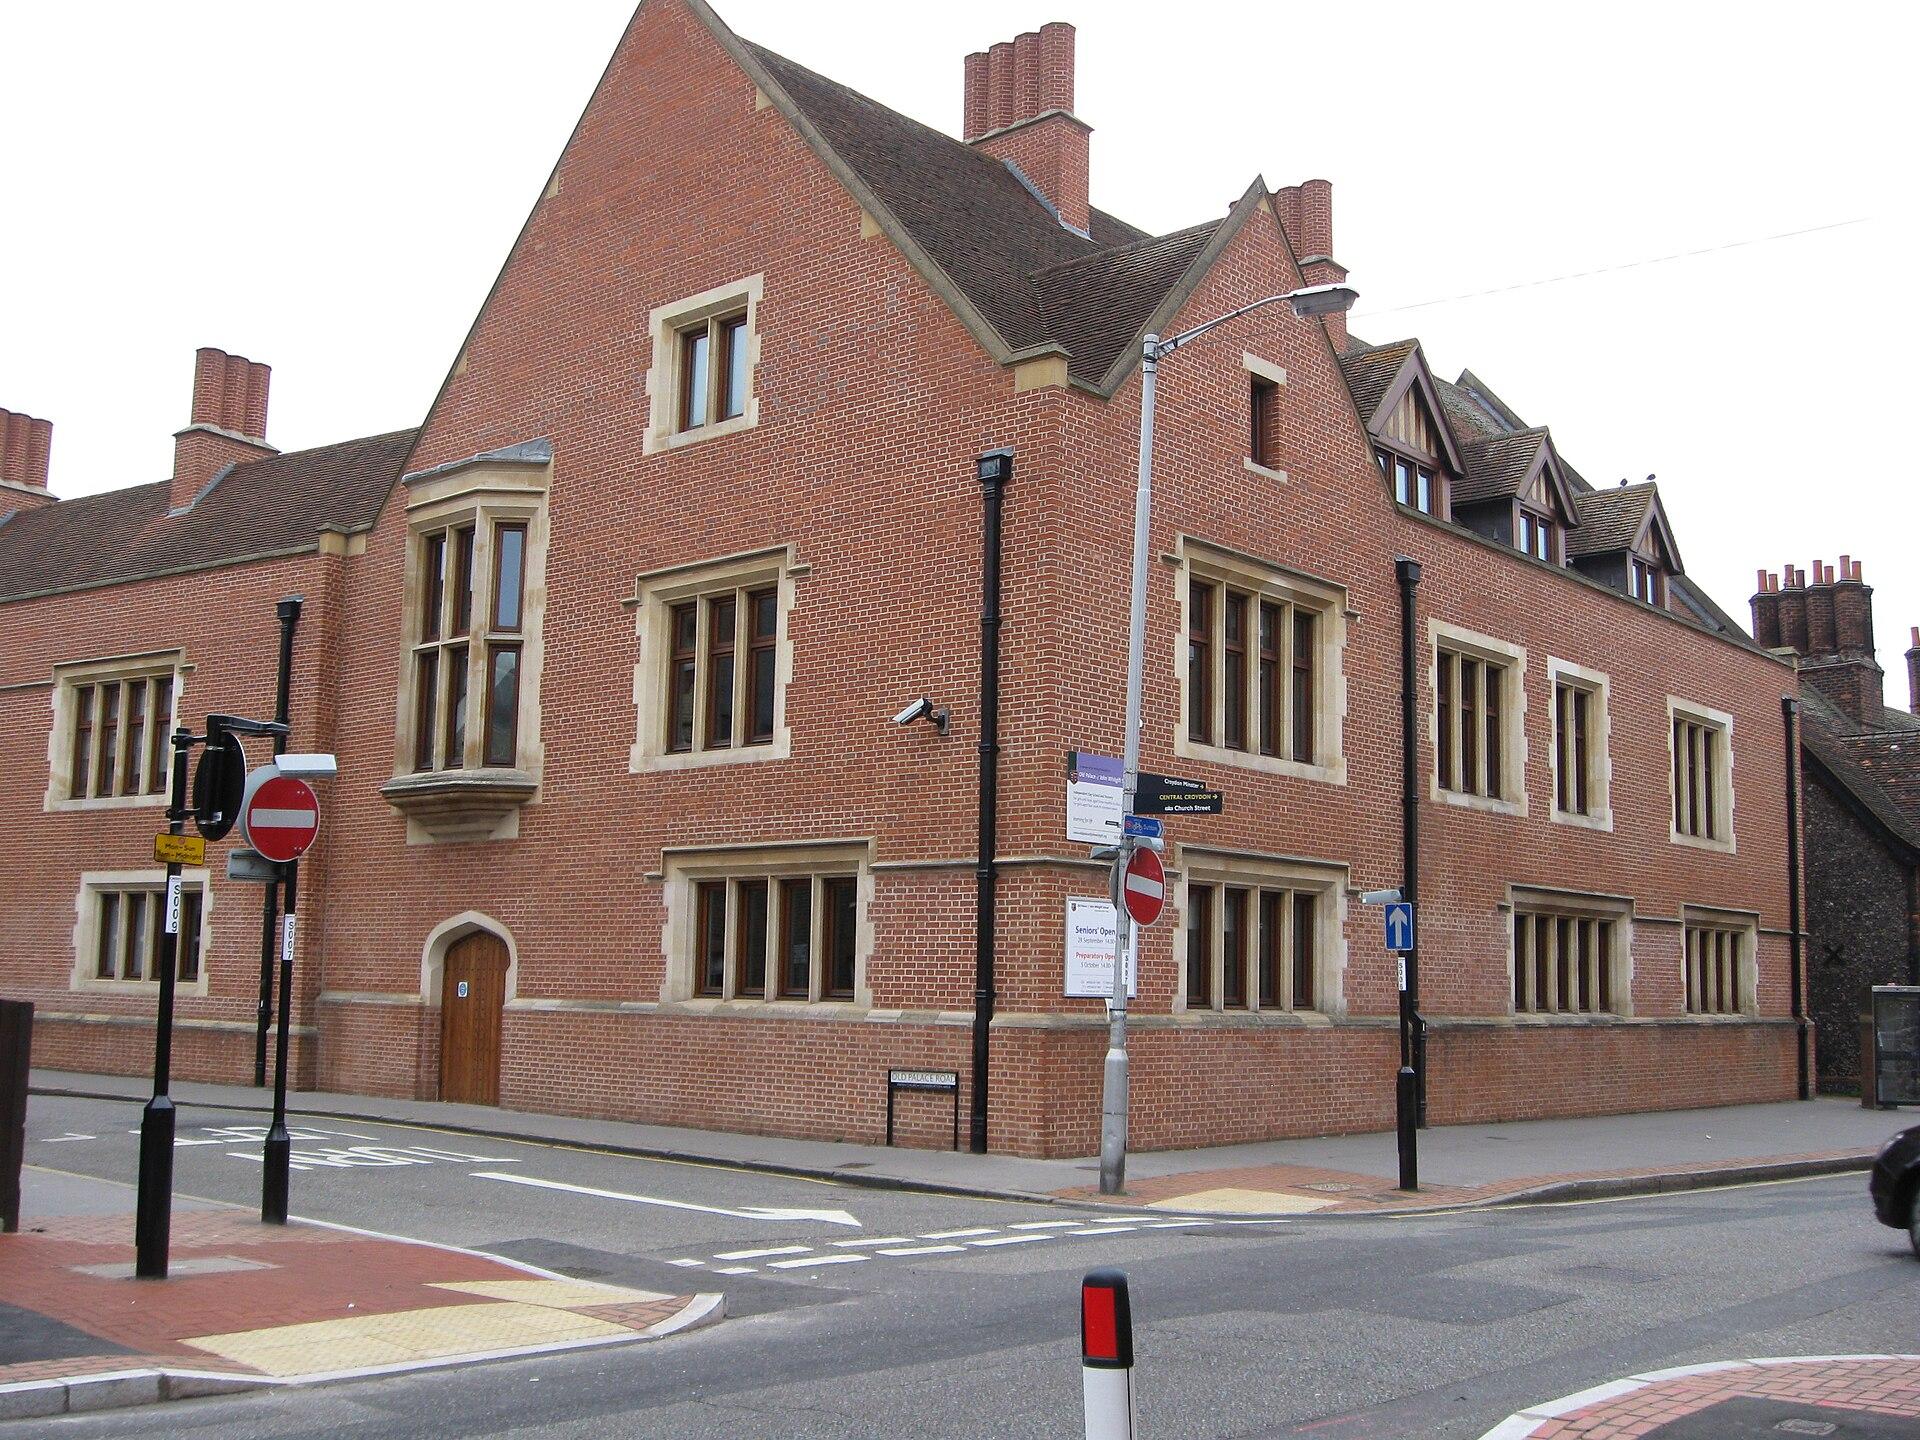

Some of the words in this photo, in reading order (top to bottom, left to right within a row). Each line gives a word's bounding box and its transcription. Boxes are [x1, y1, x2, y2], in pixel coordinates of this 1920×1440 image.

[1164, 778, 1182, 787] Croydon
[171, 884, 181, 932] S009
[1099, 927, 1115, 937] Open
[1075, 952, 1104, 961] Preparatory
[891, 1072, 907, 1081] OLD
[908, 1073, 934, 1082] PALACE
[935, 1074, 956, 1084] ROAD
